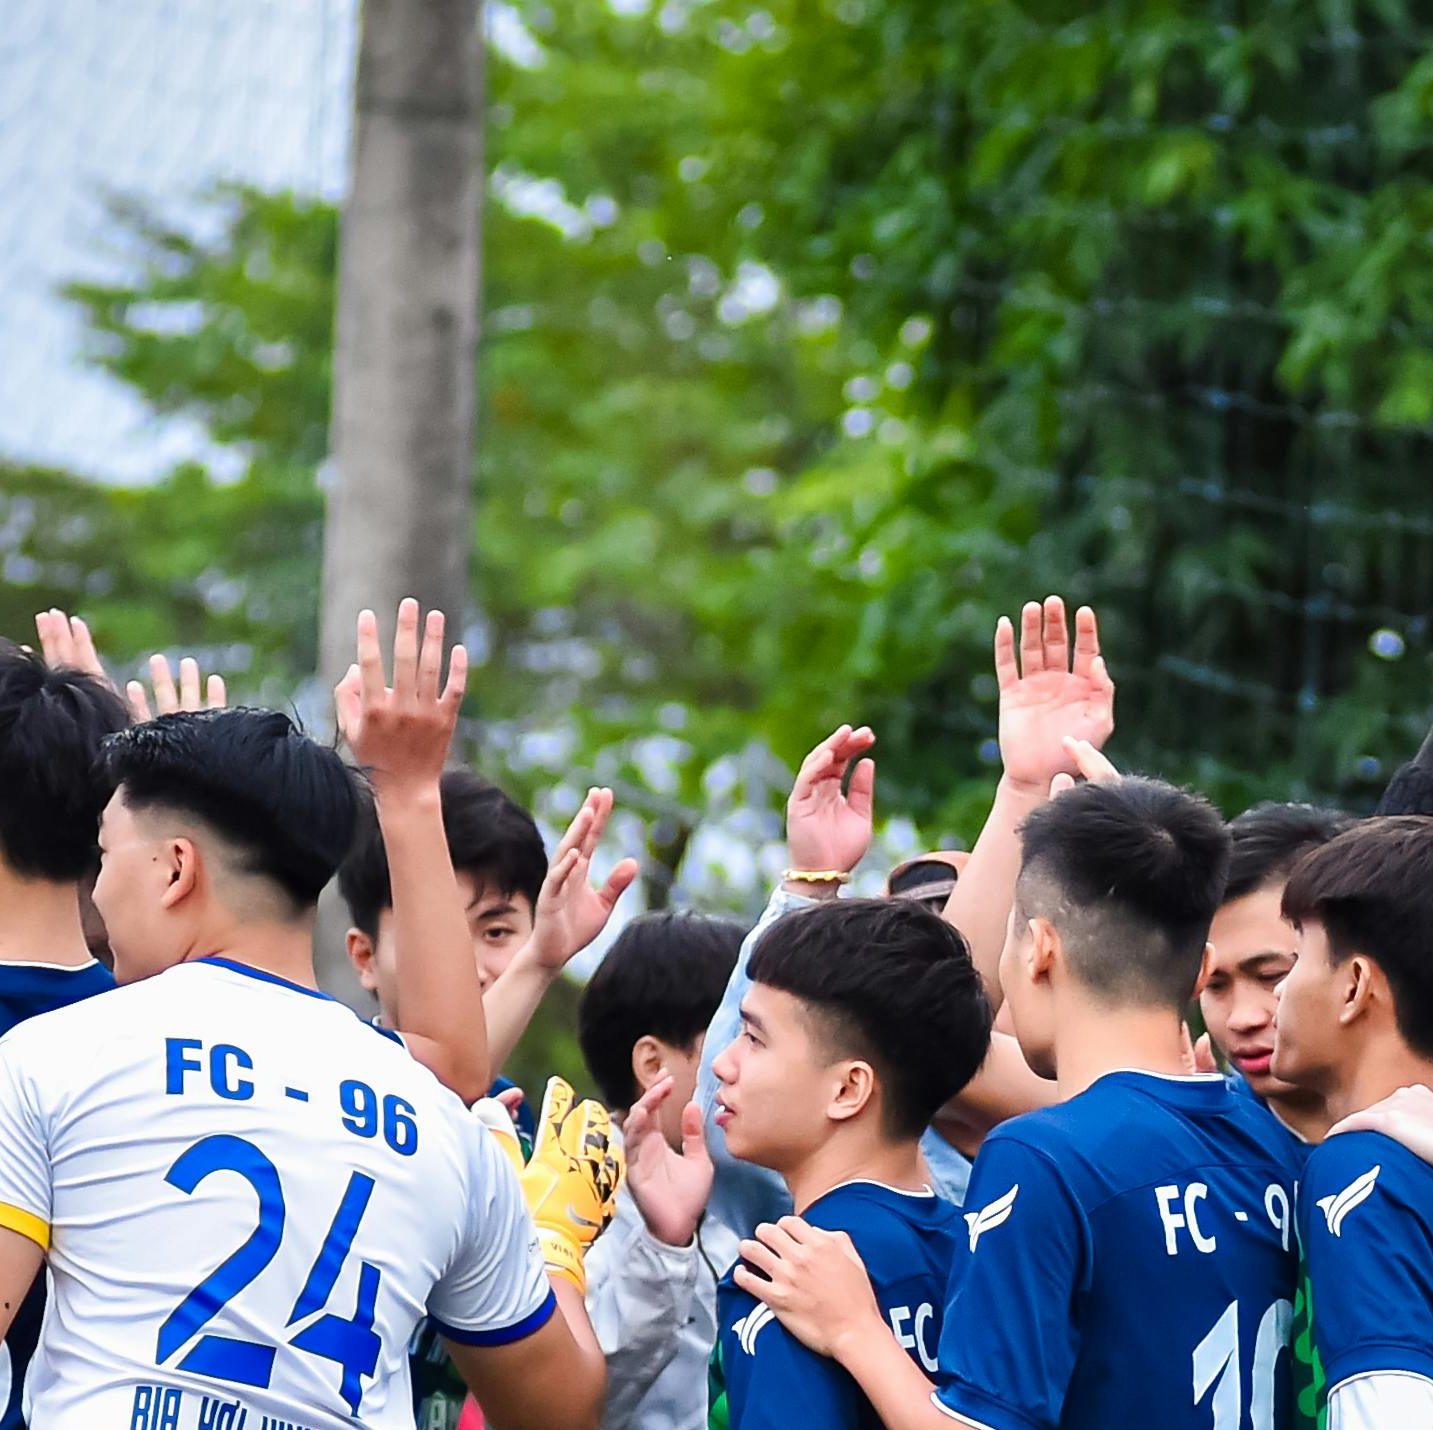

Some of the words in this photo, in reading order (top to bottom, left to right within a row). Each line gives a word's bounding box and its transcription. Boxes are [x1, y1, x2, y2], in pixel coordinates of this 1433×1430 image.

[165, 1037, 254, 1101] FC
[341, 1079, 418, 1156] 96
[1155, 1182, 1217, 1256] FC
[155, 1133, 382, 1418] 24
[889, 1302, 940, 1373] FC
